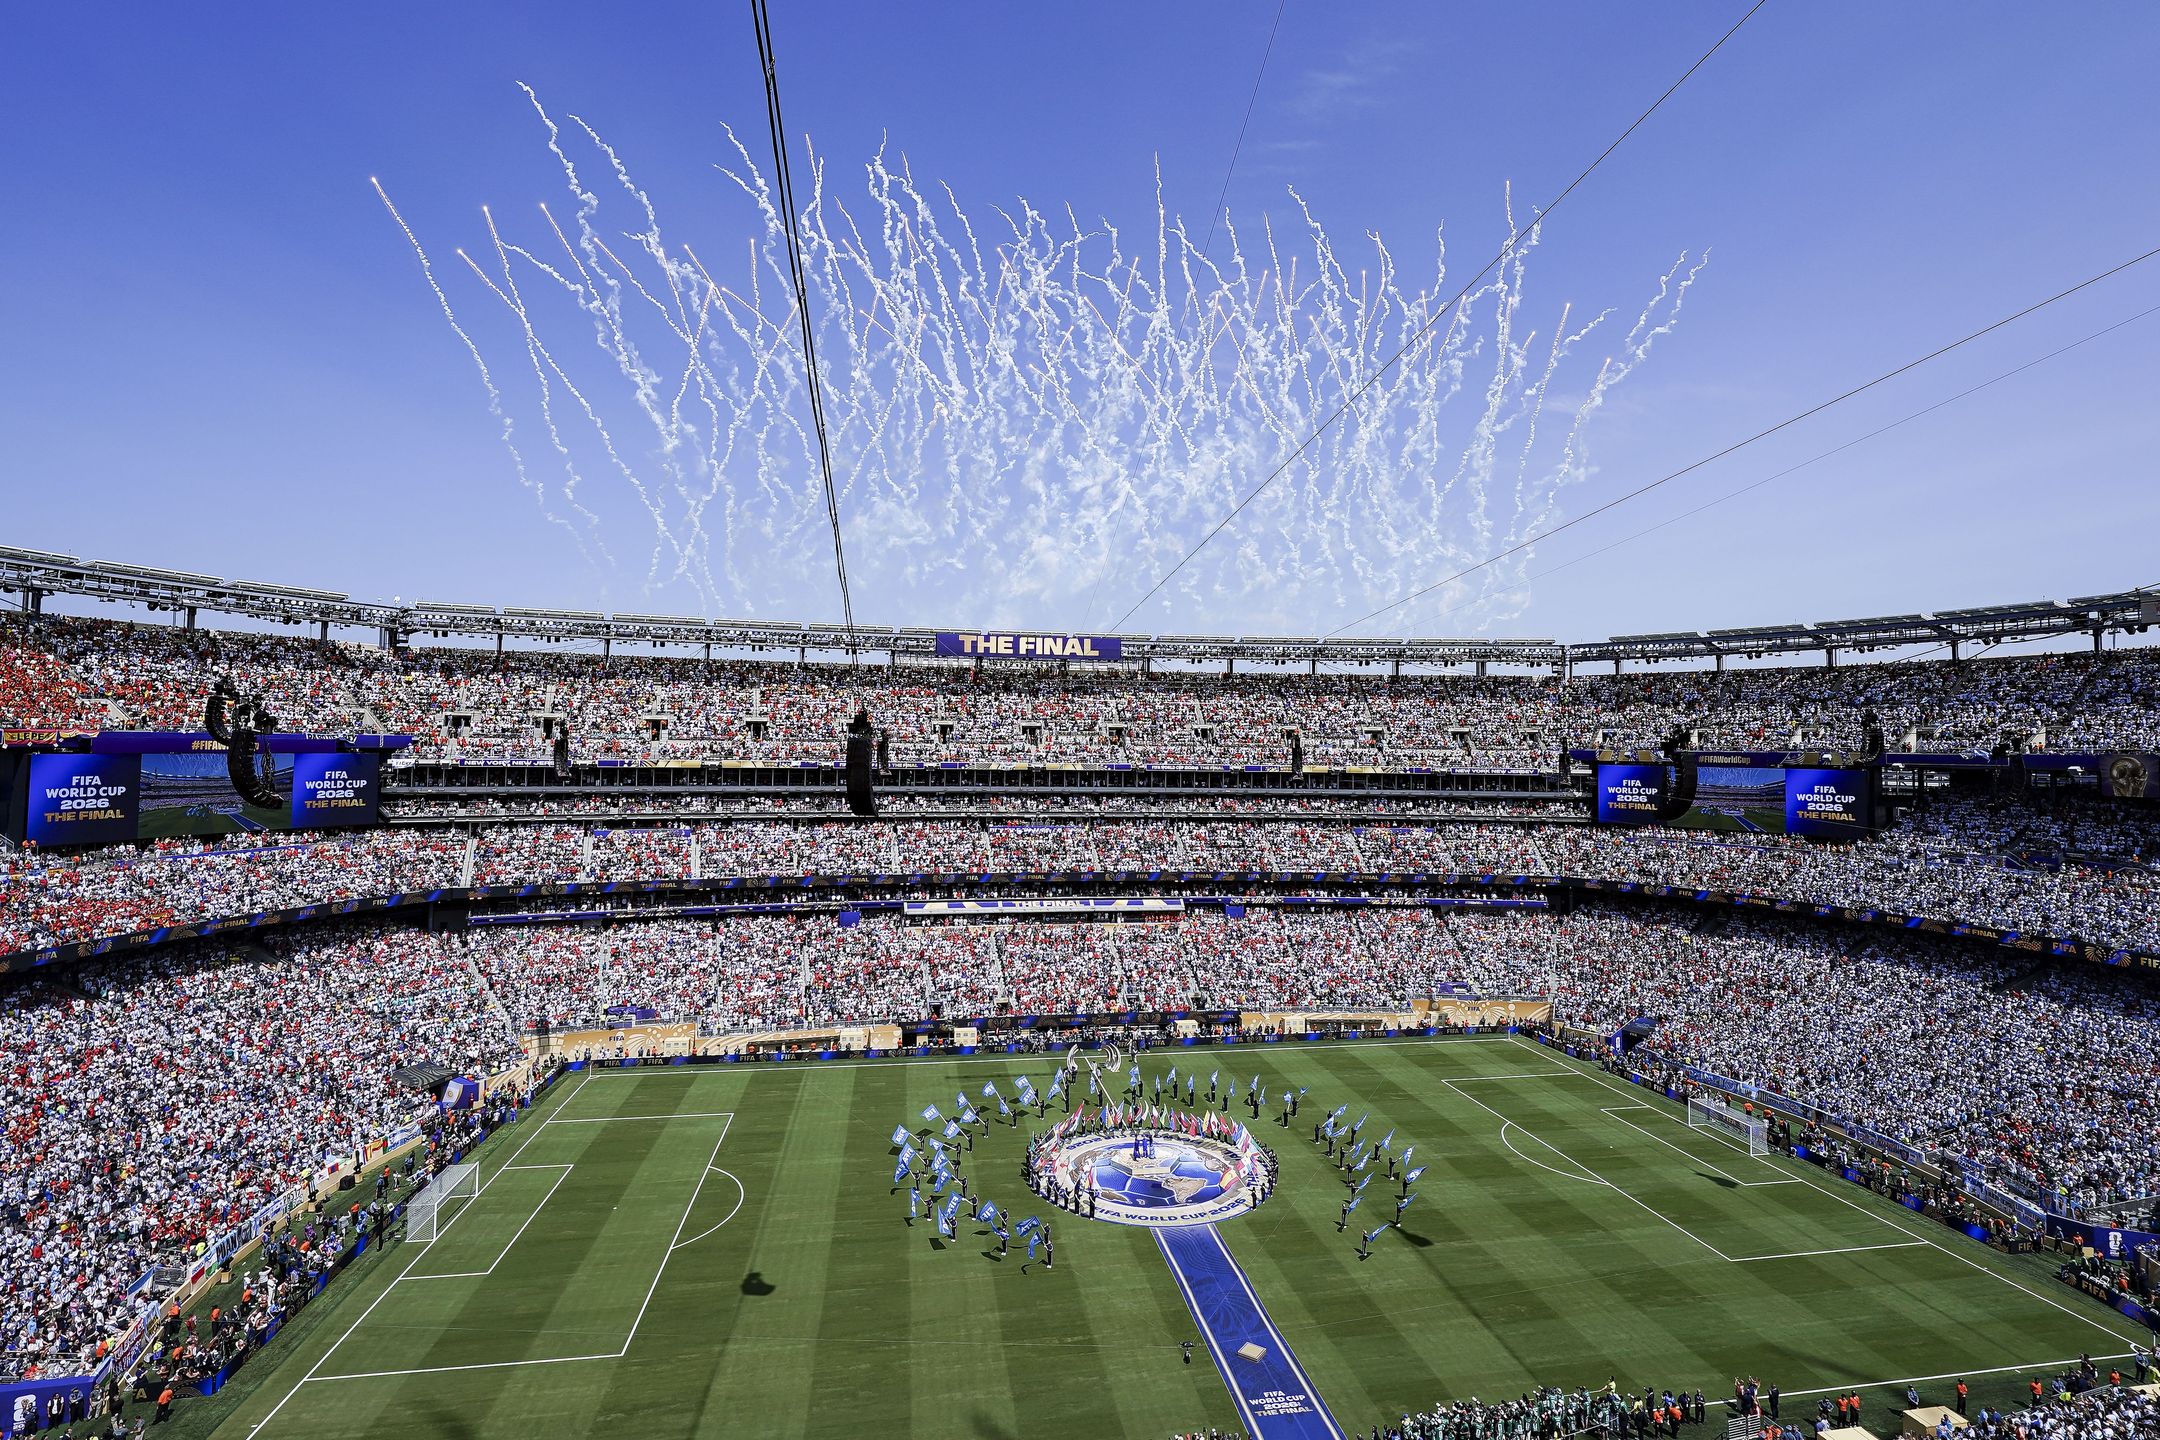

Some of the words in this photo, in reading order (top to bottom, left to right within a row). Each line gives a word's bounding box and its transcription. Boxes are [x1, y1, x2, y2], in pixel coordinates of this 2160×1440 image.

[958, 634, 1014, 654] THE
[1018, 636, 1100, 656] FINAL
[1698, 755, 1751, 765] #FIFAWorldCup
[325, 770, 348, 780] FIFA
[72, 776, 102, 786] FIFA
[305, 780, 345, 790] WORLD
[346, 780, 368, 788] CUP
[46, 788, 97, 798] WORLD
[98, 786, 126, 796] CUP
[316, 789, 354, 798] 2026
[1607, 787, 1638, 795] WORLD
[1814, 786, 1836, 794] FIFA
[304, 800, 329, 809] THE
[330, 798, 366, 808] FINAL
[1796, 794, 1834, 802] WORLD
[1834, 794, 1856, 803] CUP
[60, 798, 110, 810] 2026
[1628, 802, 1658, 811] FINAL
[1807, 802, 1844, 811] 2026
[44, 811, 77, 822] THE
[79, 809, 124, 821] FINAL
[1796, 810, 1820, 819] THE
[1820, 812, 1856, 821] FINAL
[372, 898, 388, 906] FIFA
[1014, 899, 1038, 908] THE
[1044, 899, 1086, 908] FINAL
[1735, 896, 1748, 904] THE
[1749, 898, 1770, 906] FINAL
[300, 908, 316, 916] FIFA
[1814, 906, 1830, 915] FIFA
[207, 922, 224, 930] THE
[224, 919, 250, 928] FINAL
[1886, 915, 1904, 924] FIFA
[1954, 926, 1971, 935] THE
[1972, 929, 1999, 939] FINAL
[130, 934, 150, 944] FIFA
[2052, 941, 2077, 954] FIFA
[35, 951, 58, 962] FIFA
[2140, 956, 2160, 968] FIF
[1653, 1084, 1665, 1094] FIFA
[1846, 1170, 1866, 1184] FIFA
[1896, 1193, 1916, 1208] FIFA
[1124, 1214, 1176, 1222] WORLD
[1178, 1212, 1208, 1221] CUP
[1208, 1198, 1246, 1216] 2026
[2018, 1242, 2034, 1252] FIF
[308, 1280, 320, 1300] FIFA
[2082, 1279, 2107, 1301] FIFA
[266, 1319, 282, 1340] FIFA
[1263, 1390, 1285, 1398] FIFA
[1249, 1396, 1285, 1406] WORLD
[1279, 1406, 1313, 1414] FINAL
